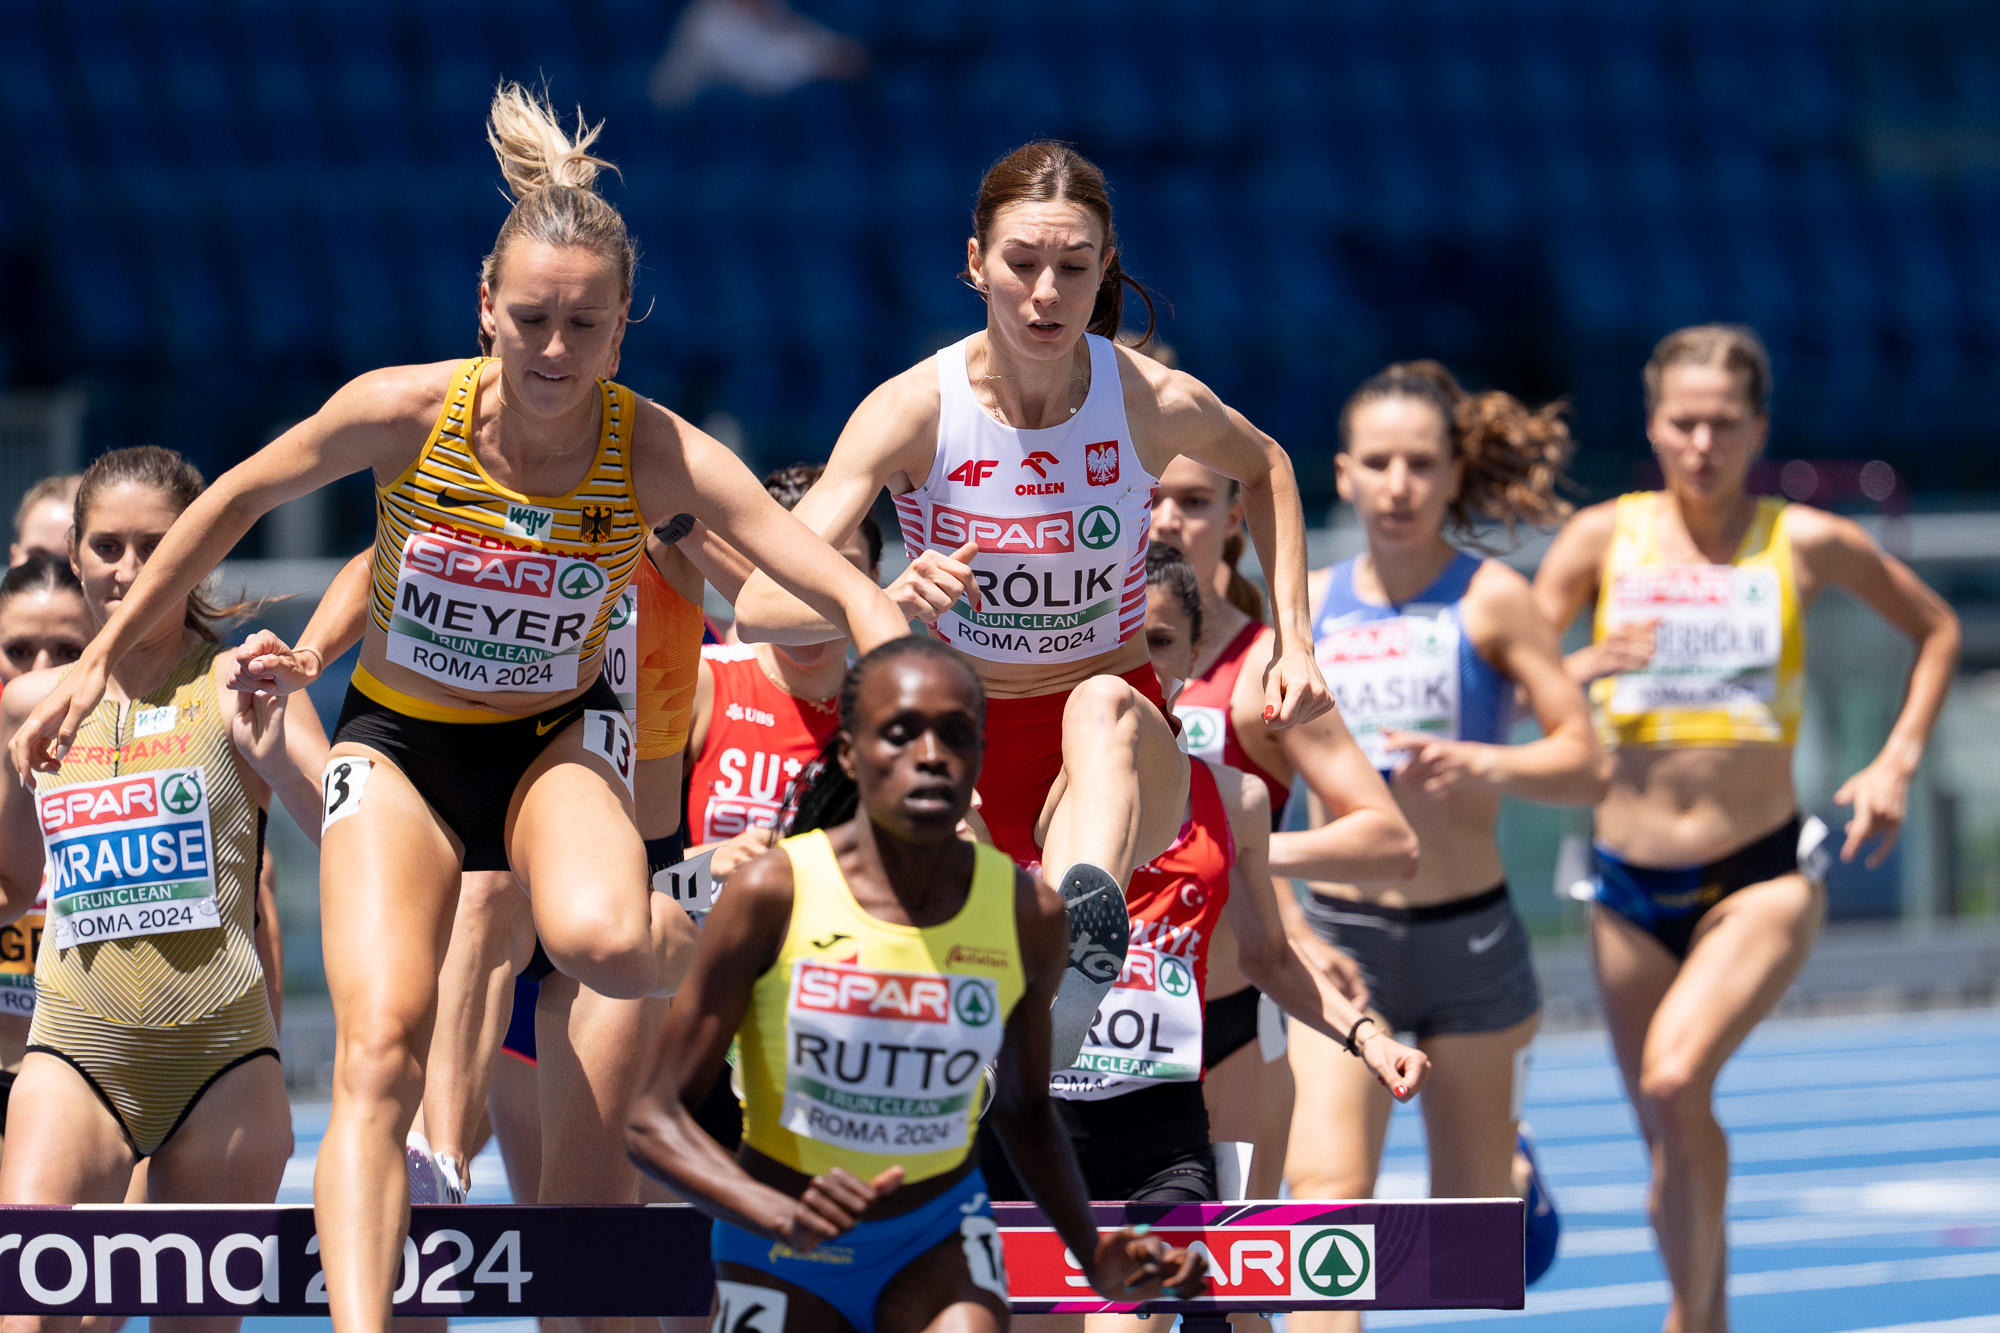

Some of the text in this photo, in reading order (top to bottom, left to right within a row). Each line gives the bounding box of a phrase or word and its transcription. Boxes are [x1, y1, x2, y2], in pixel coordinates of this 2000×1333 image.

[947, 460, 999, 486] 4F
[1015, 482, 1065, 496] ORLEN
[936, 511, 1070, 549] SPAR
[410, 541, 551, 592] SPAR
[961, 563, 1118, 607] RÓLIK
[402, 582, 585, 647] MEYER
[977, 612, 1015, 627] RUN
[440, 636, 480, 654] RUN
[958, 621, 1096, 653] ROMA 2024
[414, 647, 553, 685] ROMA 2024
[744, 707, 775, 727] UBS
[600, 715, 630, 779] 13
[42, 784, 154, 828] SPAR
[322, 763, 352, 826] 13
[53, 829, 206, 891] KRAUSE
[79, 893, 116, 909] RUN
[672, 871, 696, 899] 11
[72, 906, 193, 938] ROMA 2024
[800, 969, 948, 1018] SPAR
[795, 1033, 979, 1090] RUTTO
[833, 1092, 876, 1112] RUN
[878, 1096, 940, 1116] CLEAN
[809, 1108, 948, 1145] ROMA 2024
